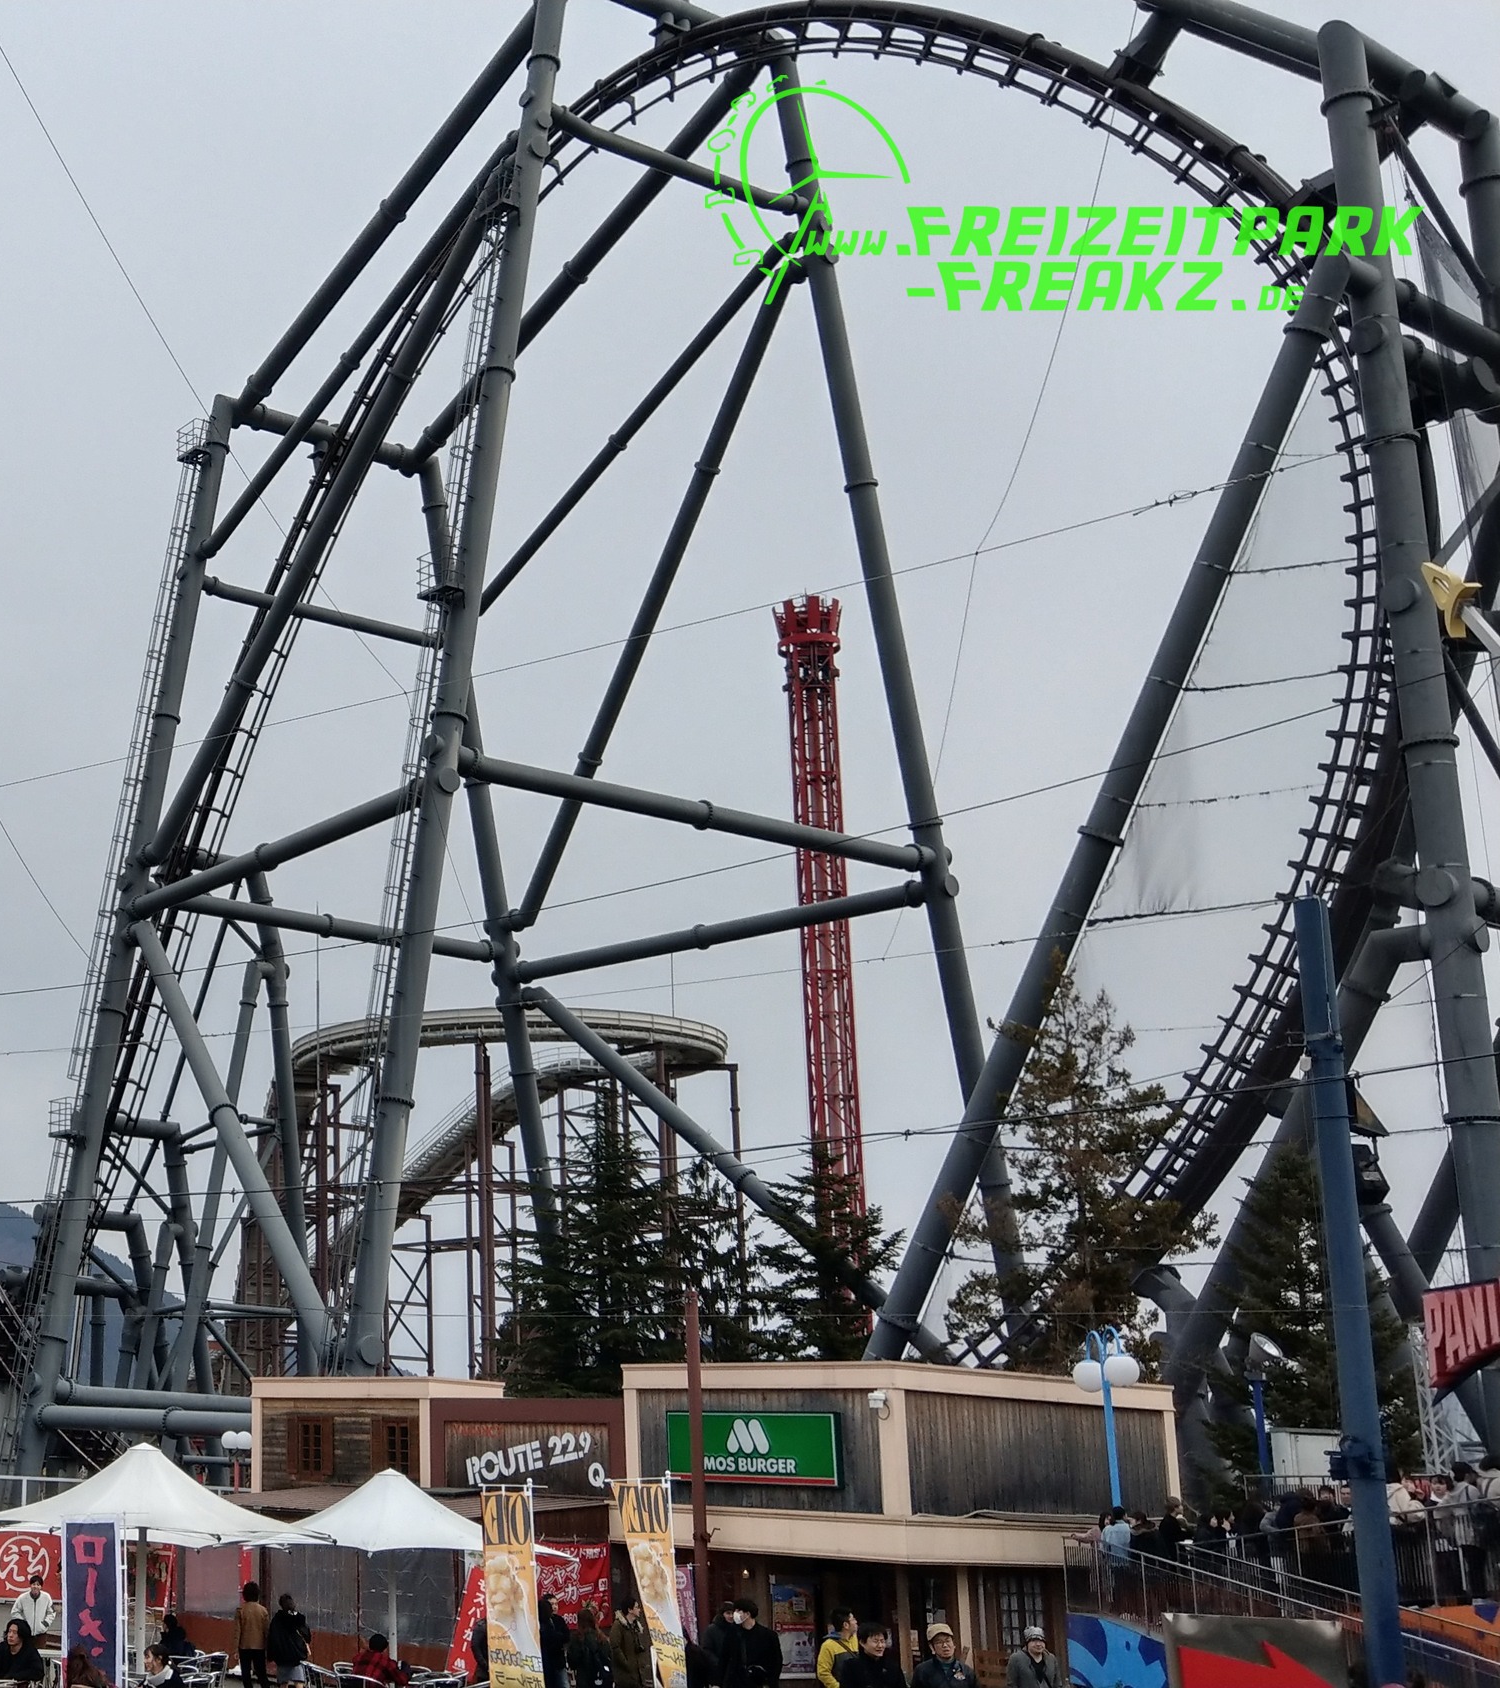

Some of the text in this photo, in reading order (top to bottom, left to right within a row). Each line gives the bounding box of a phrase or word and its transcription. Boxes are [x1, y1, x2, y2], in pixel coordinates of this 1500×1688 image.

[465, 1431, 591, 1486] ROUTE 22.9
[704, 1456, 796, 1474] MOS BURGER
[588, 1462, 605, 1488] Q
